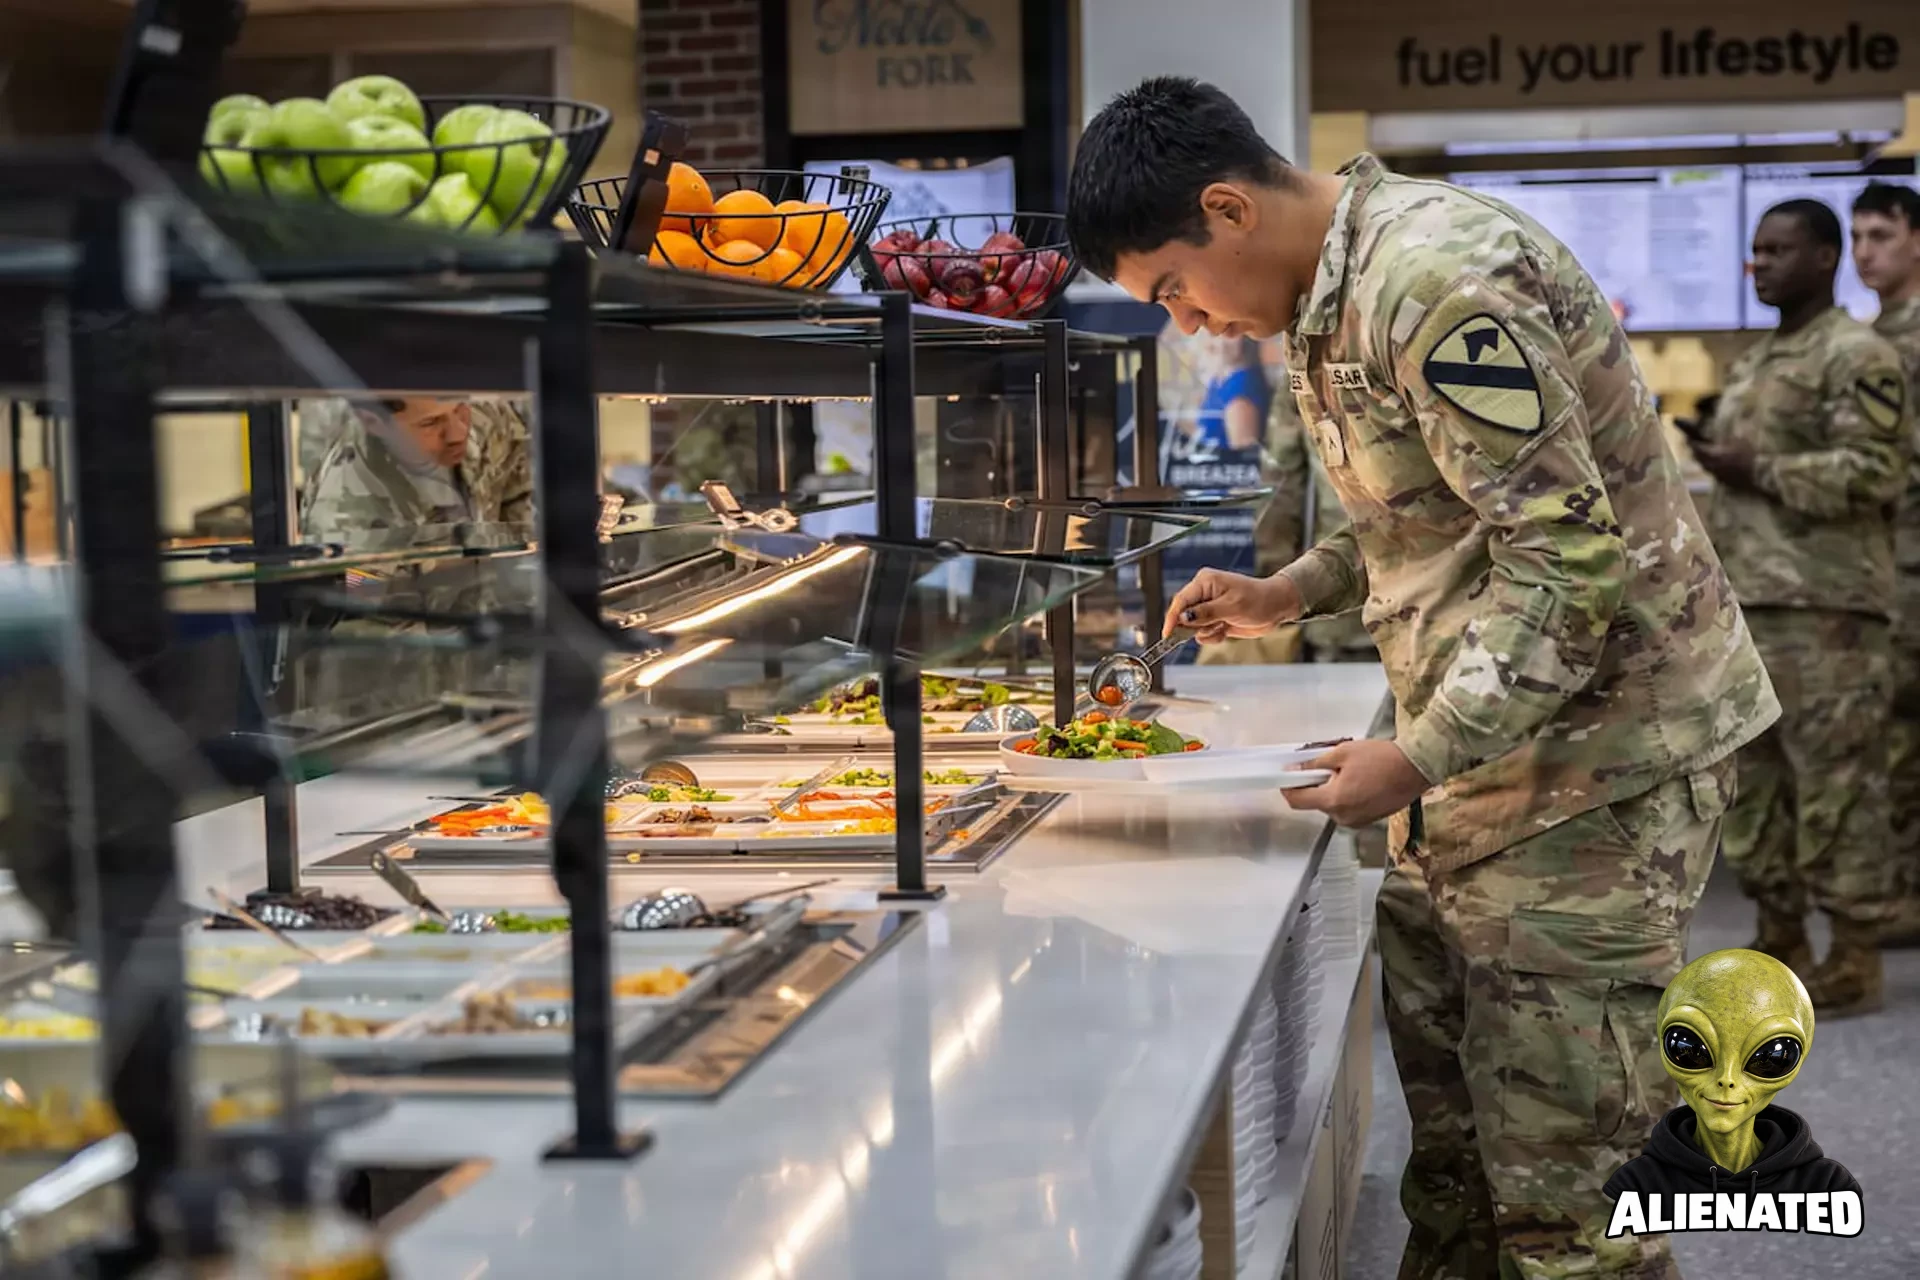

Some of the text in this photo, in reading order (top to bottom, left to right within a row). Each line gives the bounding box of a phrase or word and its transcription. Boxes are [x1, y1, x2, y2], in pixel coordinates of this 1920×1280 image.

[876, 53, 975, 89] FORK
[1396, 20, 1900, 94] fuel your lifestyle
